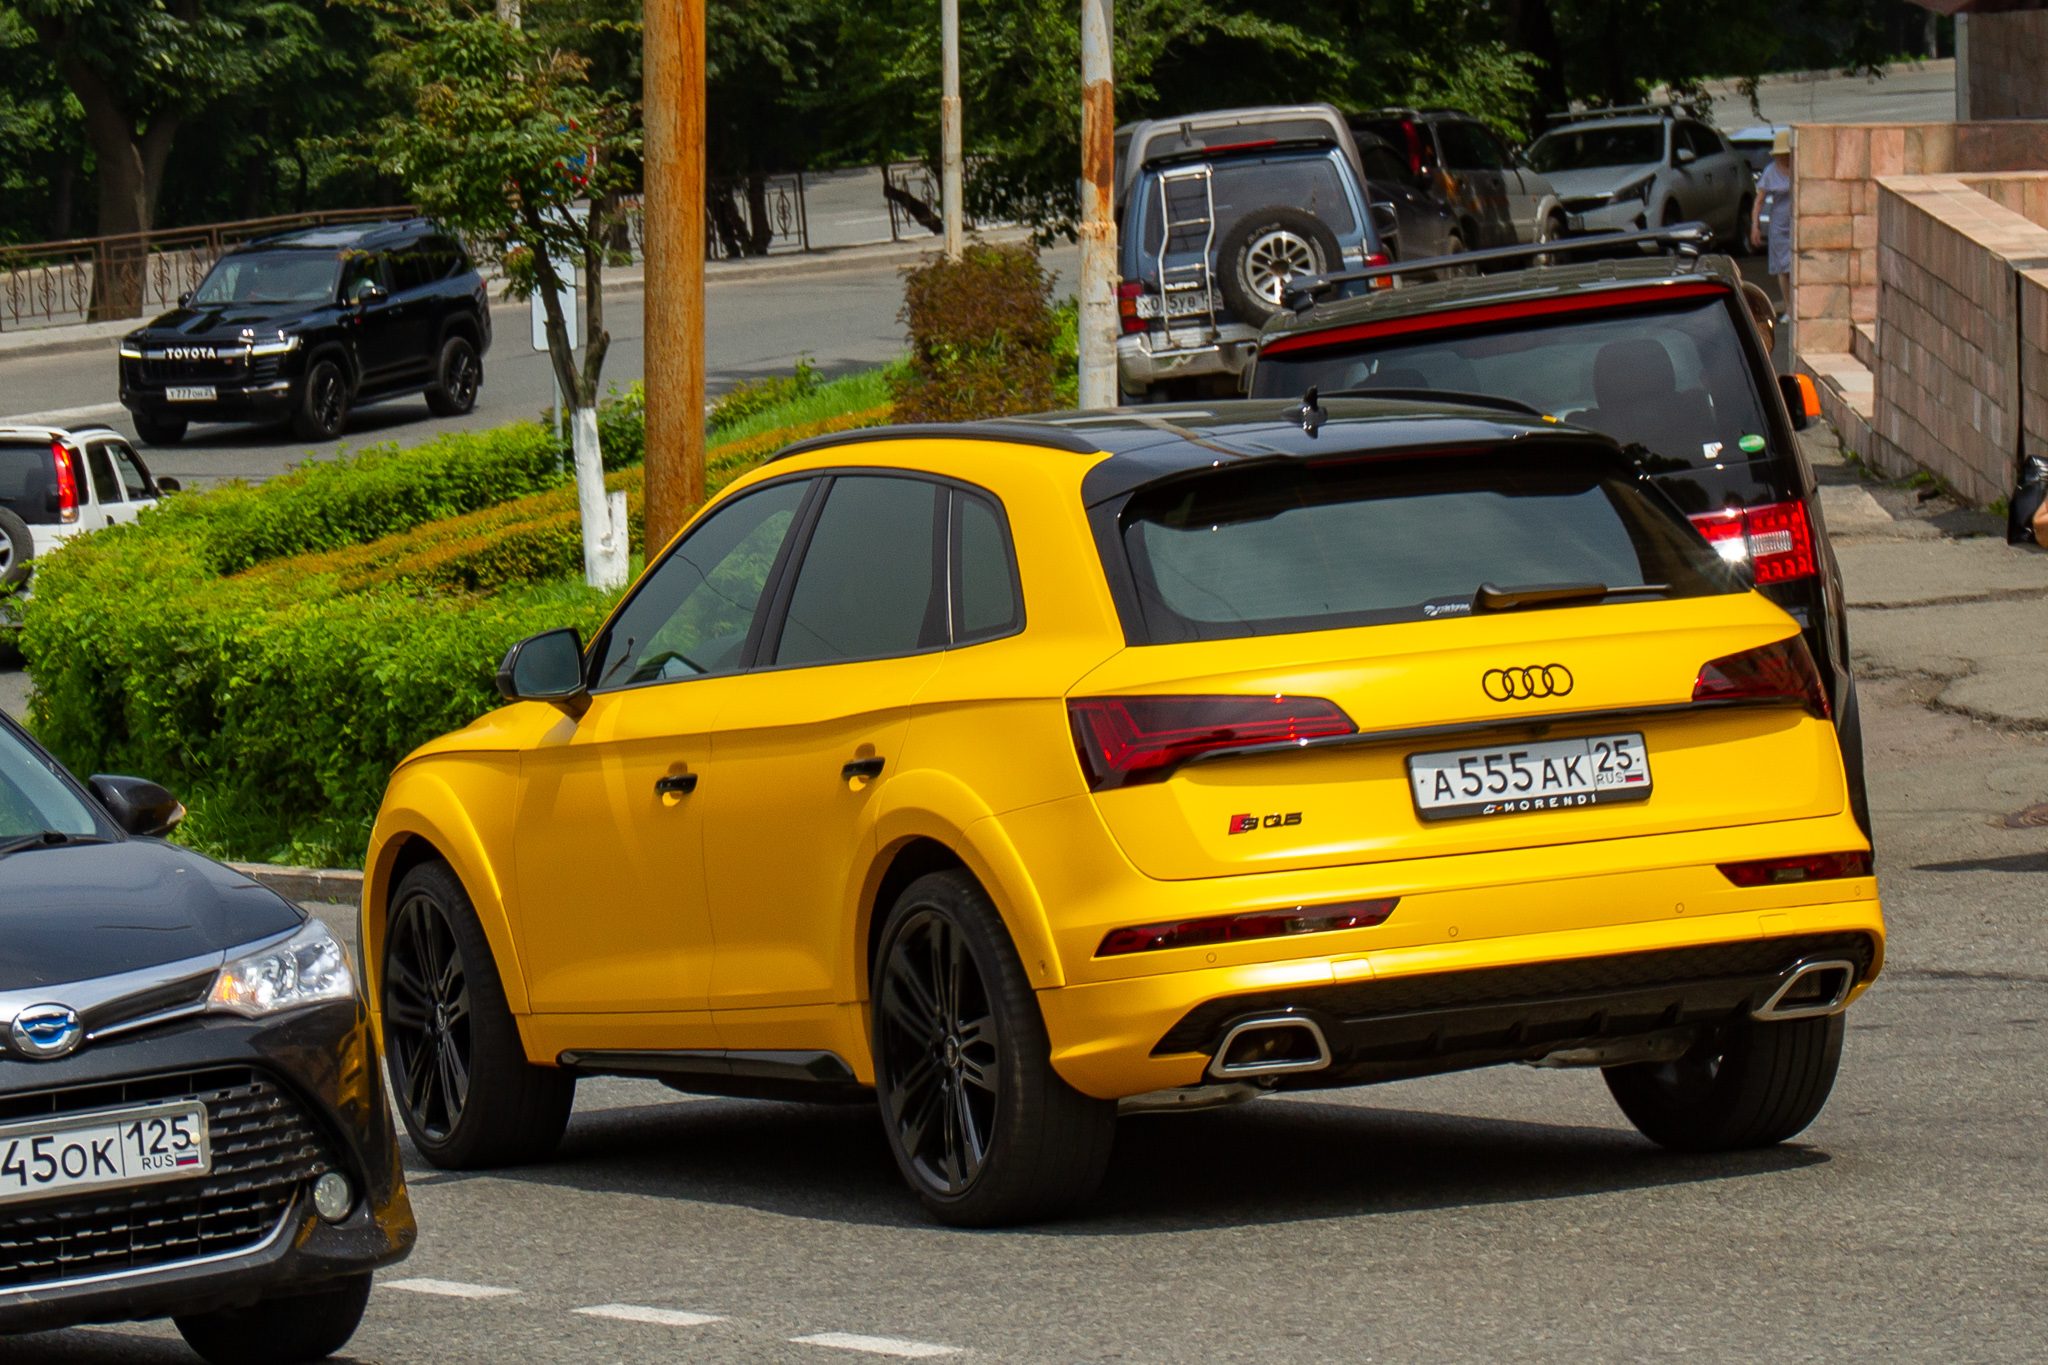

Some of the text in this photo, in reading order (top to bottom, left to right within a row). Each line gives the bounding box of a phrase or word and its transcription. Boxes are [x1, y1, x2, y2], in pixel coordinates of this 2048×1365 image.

[166, 347, 217, 359] TOYOTA
[1433, 739, 1633, 801] A555AK 25
[1596, 769, 1625, 785] RUS
[1240, 811, 1303, 831] SQ5
[126, 1115, 191, 1157] 125
[142, 1154, 174, 1171] RUS
